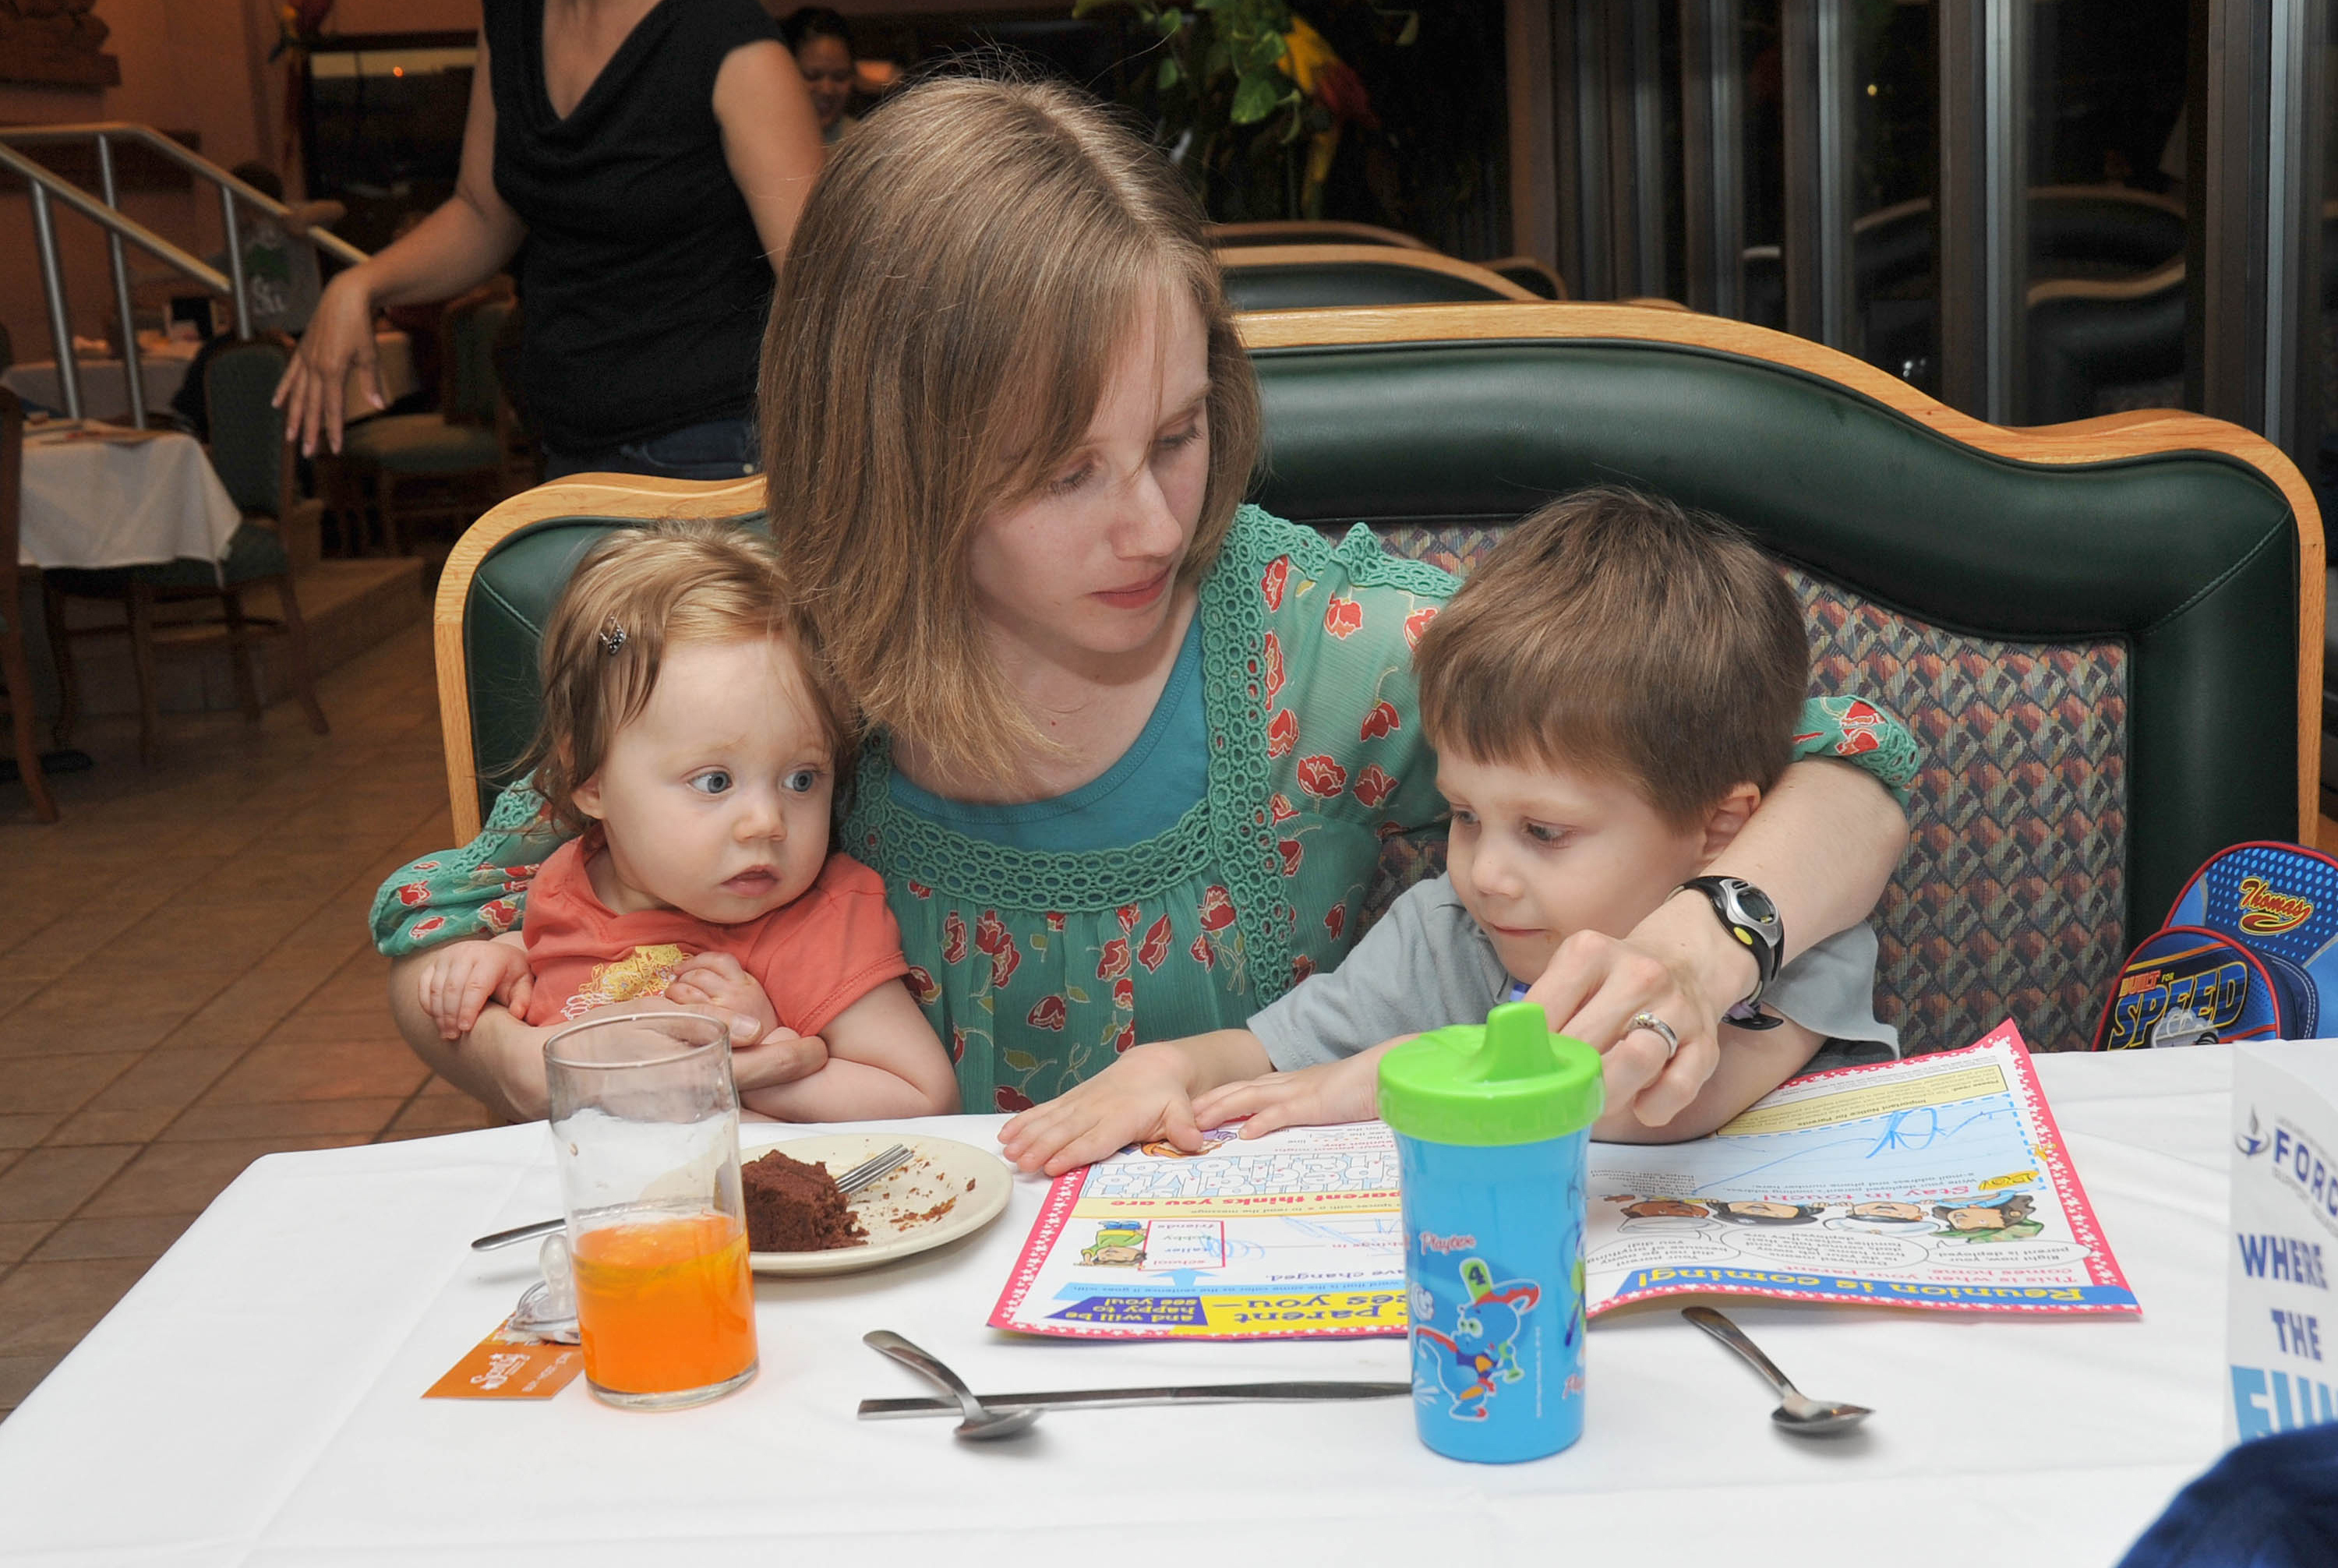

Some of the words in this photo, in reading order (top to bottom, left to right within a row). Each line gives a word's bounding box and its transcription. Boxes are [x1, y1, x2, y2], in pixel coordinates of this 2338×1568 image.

[2238, 876, 2313, 927] Thomas
[2118, 970, 2161, 998] BUILT
[2161, 972, 2174, 982] FOR
[2107, 961, 2248, 1051] SPEED
[1315, 1191, 1400, 1202] parent
[1904, 1186, 1969, 1197] Stay
[1222, 1196, 1305, 1206] thinks
[1419, 1231, 1476, 1256] Playtex
[2237, 1233, 2329, 1290] WHERE
[1266, 1272, 1364, 1282] changed.
[1467, 1265, 1486, 1286] 4
[1637, 1268, 1821, 1287] coming!
[1835, 1279, 1874, 1294] is
[1888, 1283, 2085, 1301] Reunion
[1104, 1297, 1154, 1307] you!
[1122, 1305, 1195, 1315] happy
[1065, 1312, 1093, 1323] be
[1100, 1313, 1143, 1323] will
[1151, 1314, 1194, 1323] and
[1233, 1305, 1382, 1324] parent
[2269, 1308, 2322, 1361] THE
